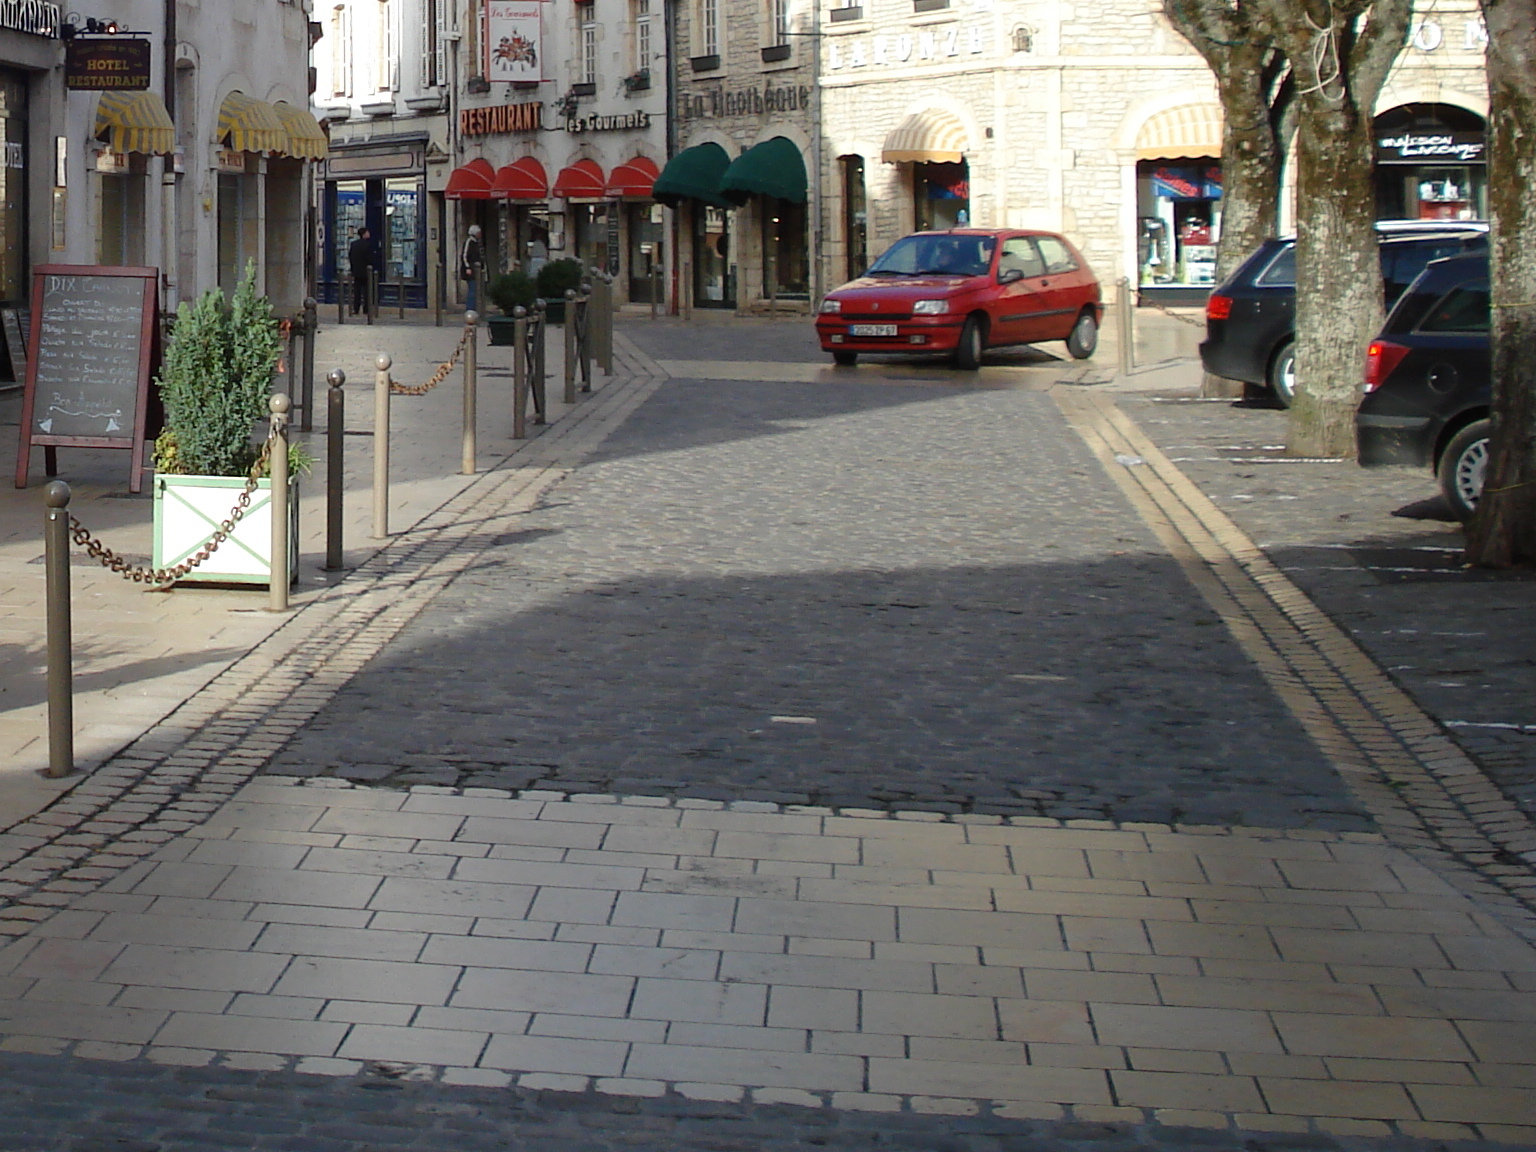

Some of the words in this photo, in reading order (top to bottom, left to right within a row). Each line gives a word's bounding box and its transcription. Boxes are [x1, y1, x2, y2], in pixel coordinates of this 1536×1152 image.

[86, 59, 130, 70] HOTEL
[68, 75, 148, 86] RESTAURANT
[461, 102, 541, 135] RESTAURANT
[586, 110, 648, 131] Gourmets
